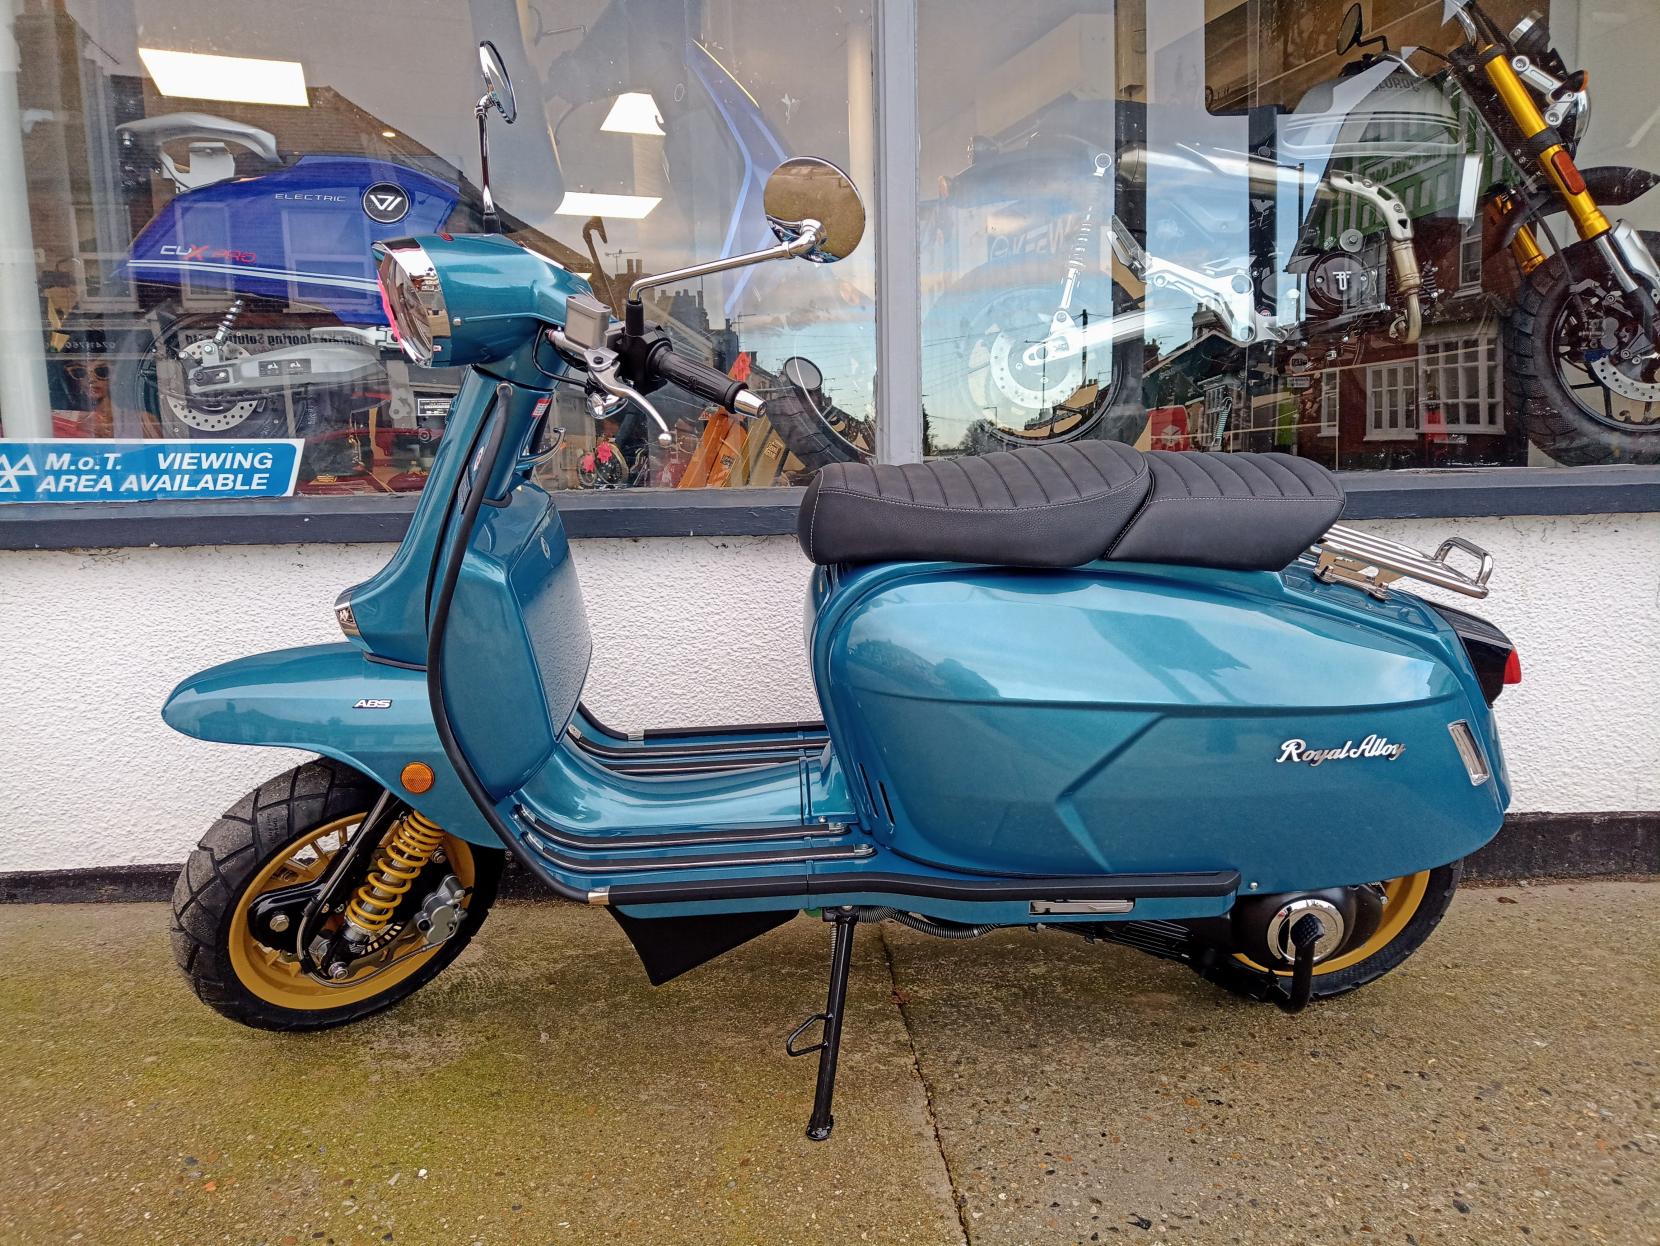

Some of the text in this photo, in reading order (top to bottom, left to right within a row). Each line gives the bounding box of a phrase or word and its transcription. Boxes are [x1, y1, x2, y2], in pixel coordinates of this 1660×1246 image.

[274, 193, 347, 202] ELECTRIC
[160, 244, 209, 261] CUX
[45, 452, 273, 470] M.o.T. VIEWING
[37, 473, 270, 493] AREA AVAILABLE
[353, 699, 391, 708] ABS
[1276, 734, 1407, 767] Royal Alloy
